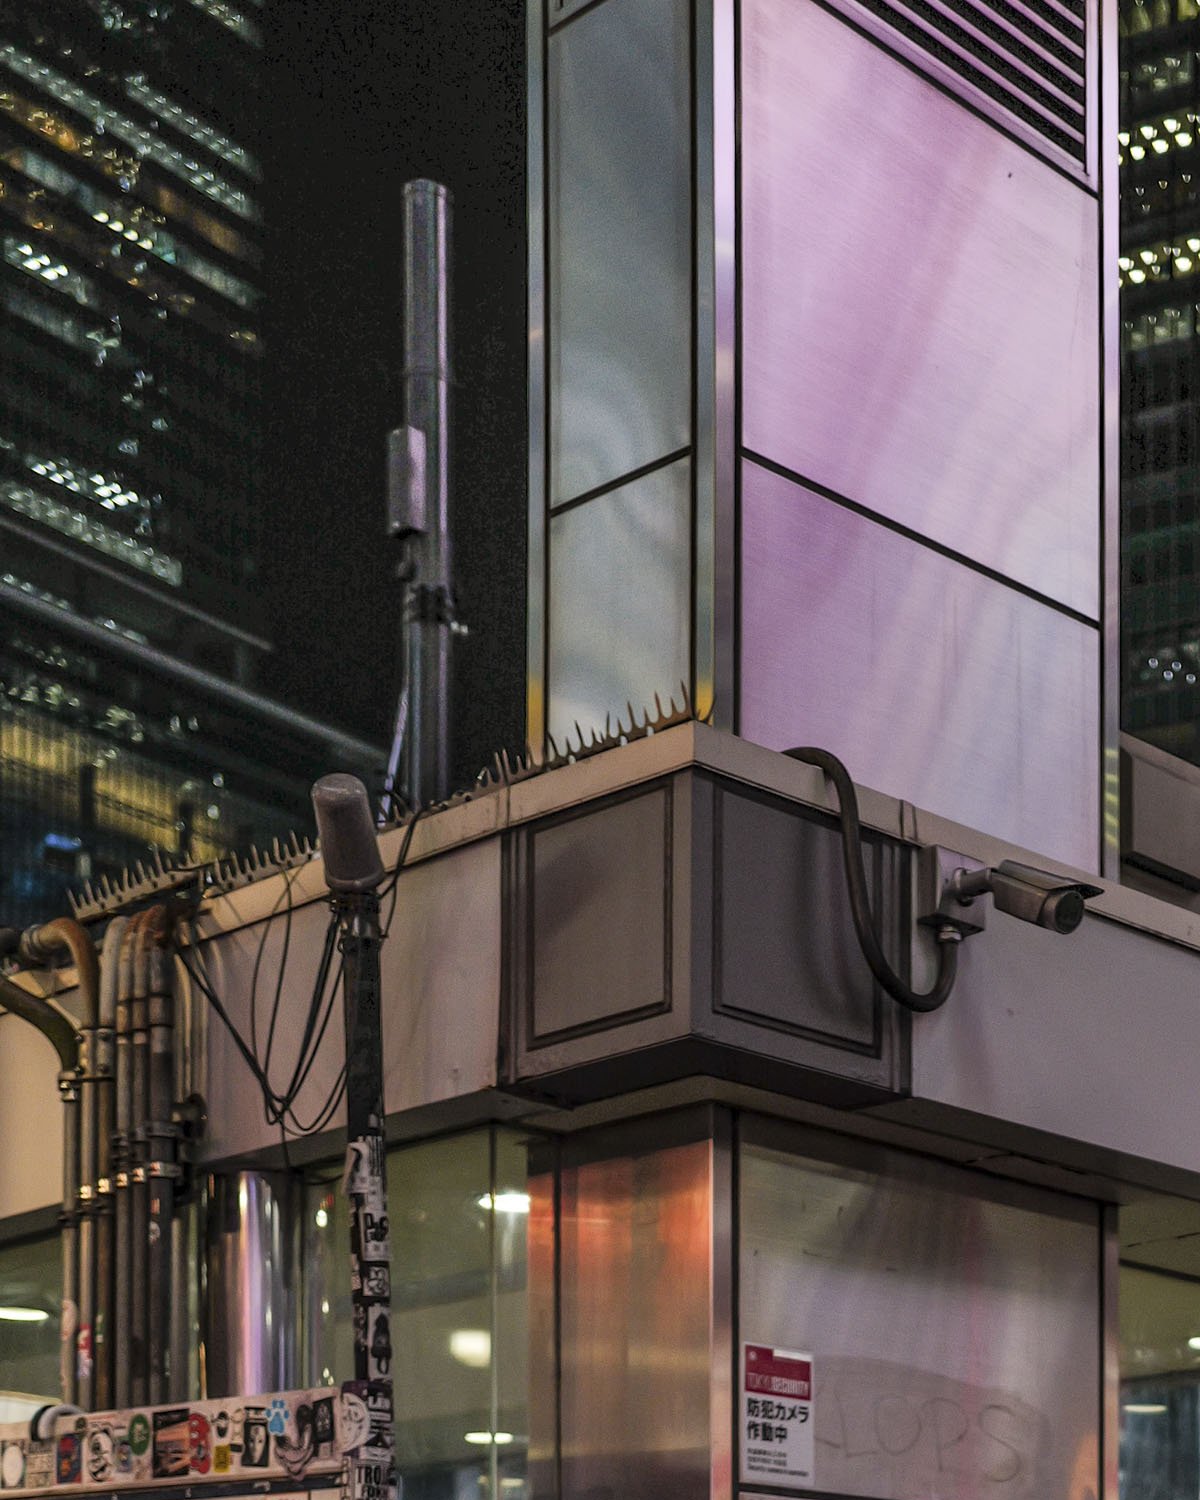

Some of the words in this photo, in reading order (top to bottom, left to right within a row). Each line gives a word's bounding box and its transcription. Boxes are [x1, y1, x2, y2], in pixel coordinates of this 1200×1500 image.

[746, 1397, 809, 1424] 防犯カメラ
[746, 1421, 788, 1444] 作動中
